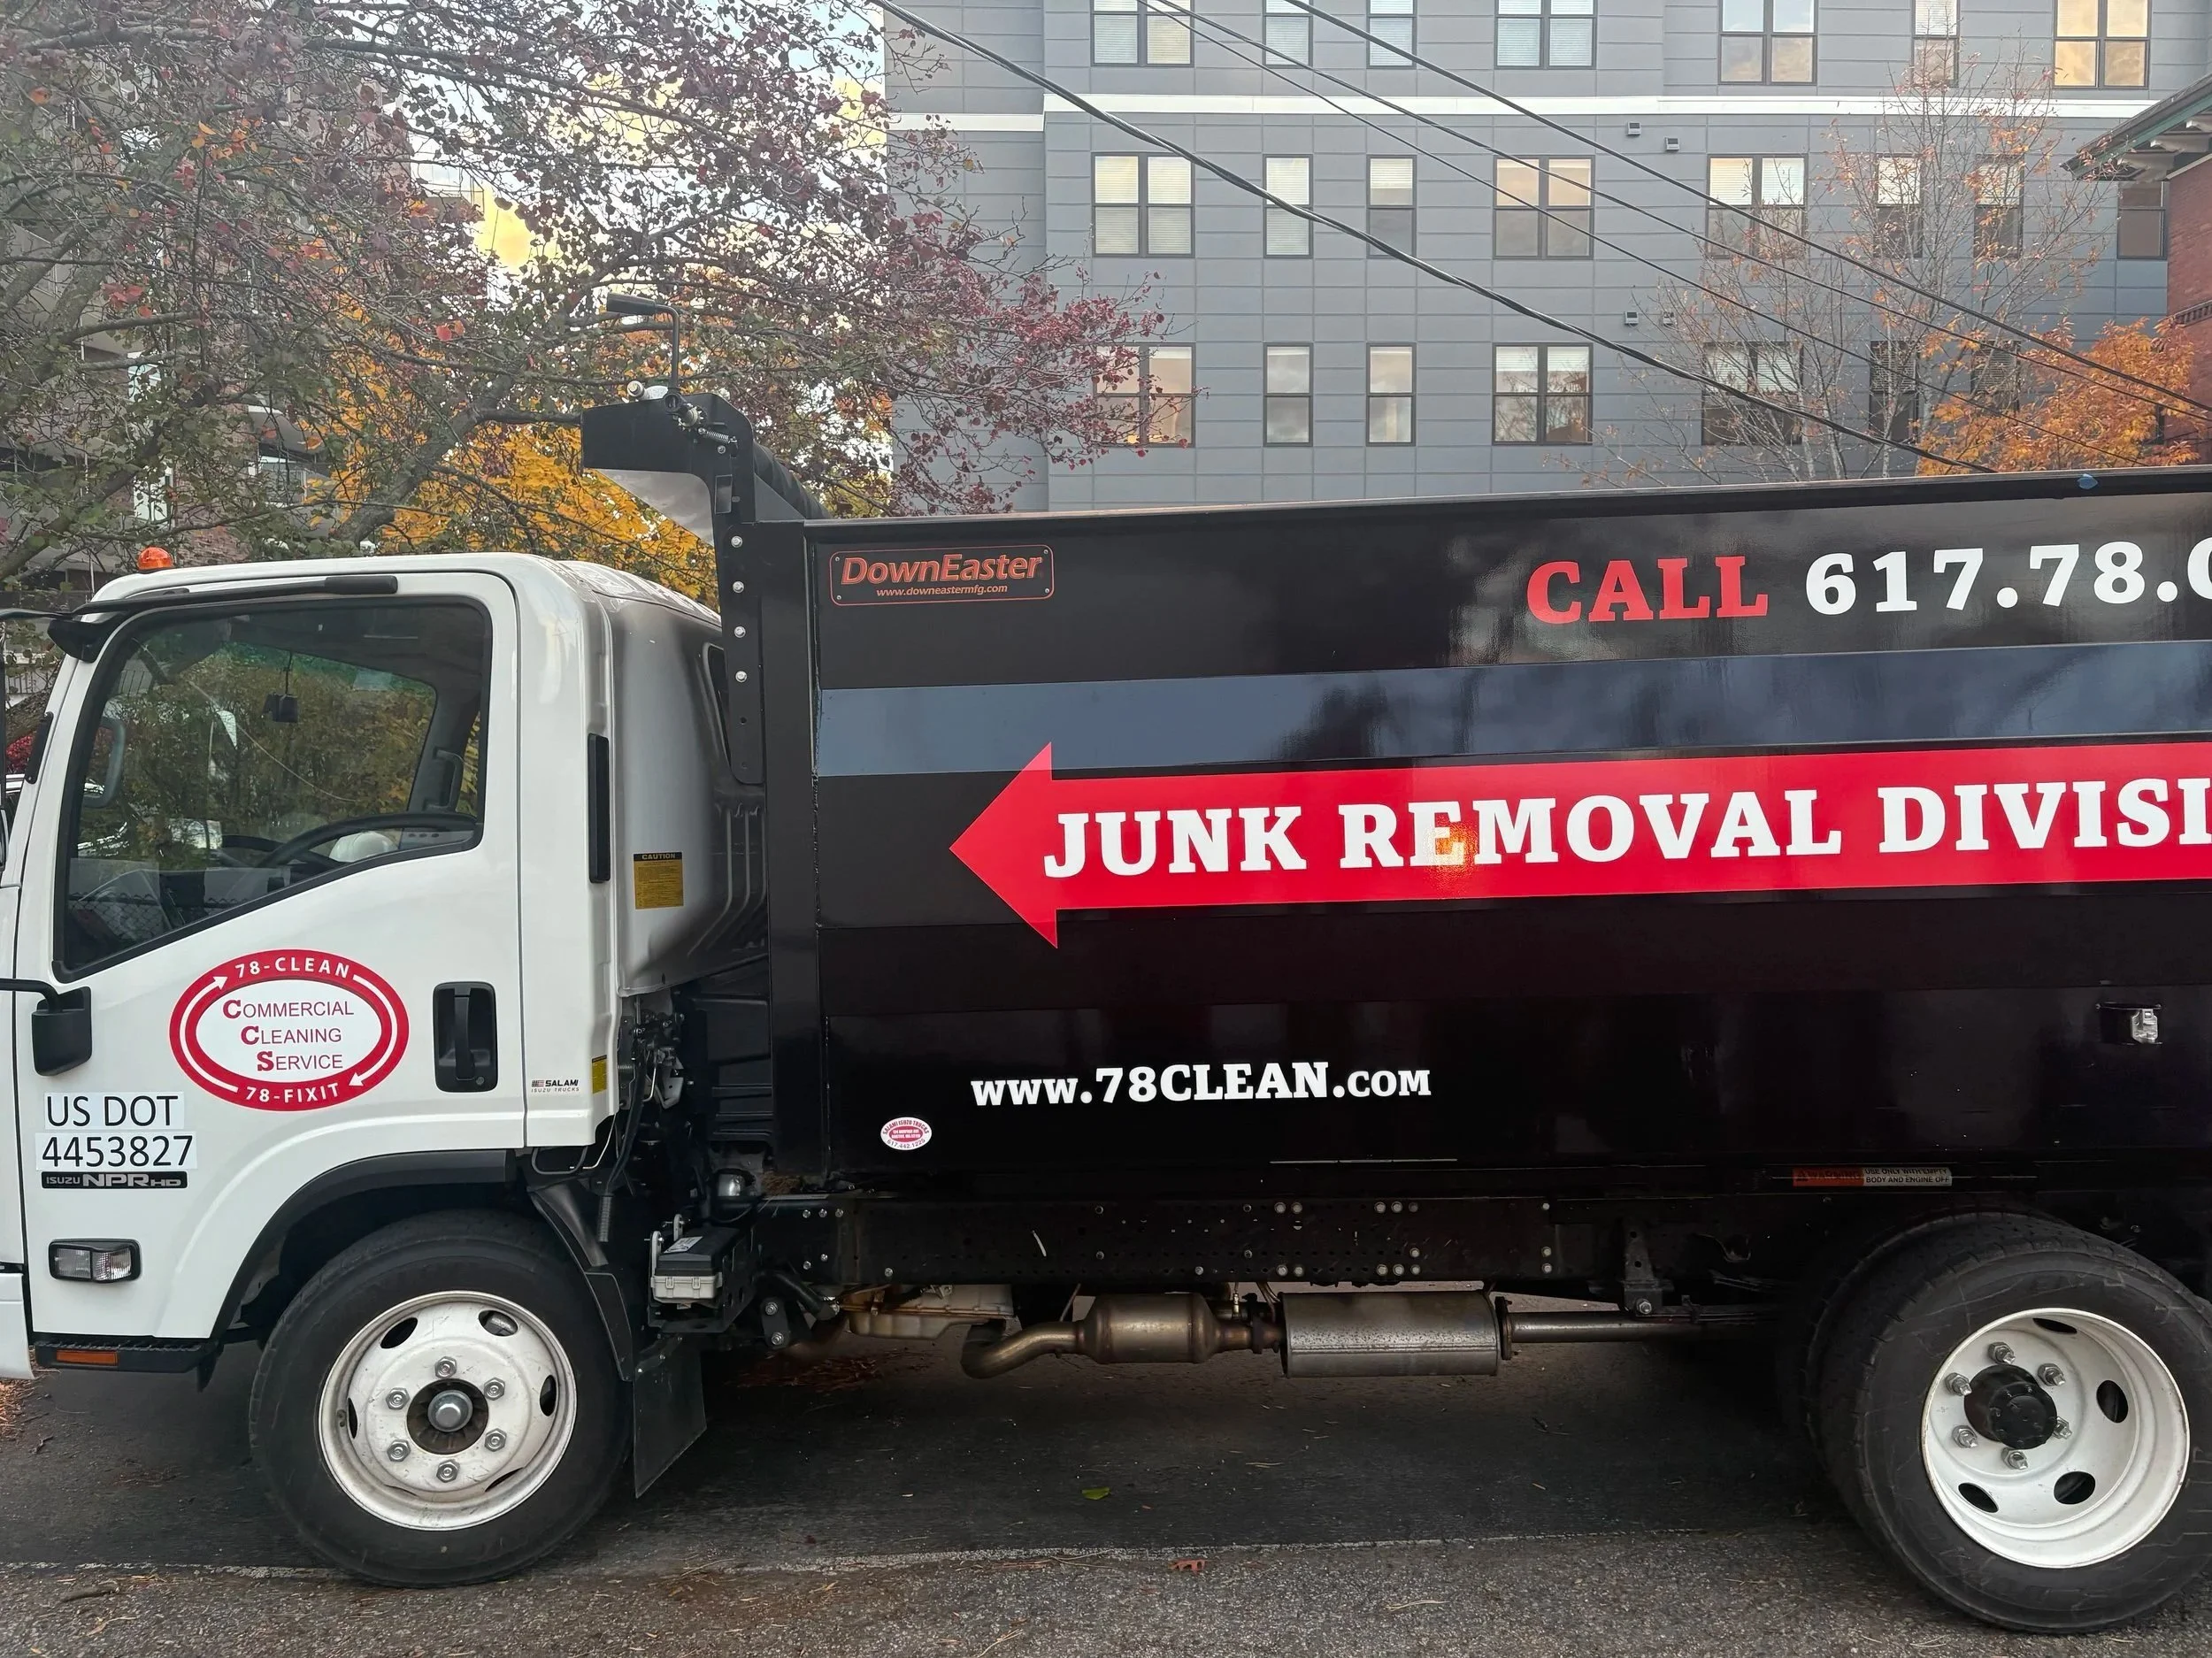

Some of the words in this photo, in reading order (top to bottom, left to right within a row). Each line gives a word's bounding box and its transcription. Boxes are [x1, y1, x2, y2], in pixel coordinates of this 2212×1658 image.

[841, 554, 1042, 586] DownEaster
[876, 584, 1008, 597] www.downeastermfg.com
[1527, 557, 1768, 624] CALL
[1044, 807, 1306, 878] JUNK
[1339, 789, 1842, 869] REMOVAL
[235, 957, 349, 979] 78-CLEAN
[223, 1000, 354, 1019] COMMERCIAL
[241, 1026, 342, 1045] CLEANING
[257, 1051, 343, 1071] SERVICE
[245, 1083, 339, 1103] 78-FIXIT
[47, 1095, 90, 1127] US
[104, 1095, 179, 1126] DOT
[42, 1135, 193, 1168] 4453827
